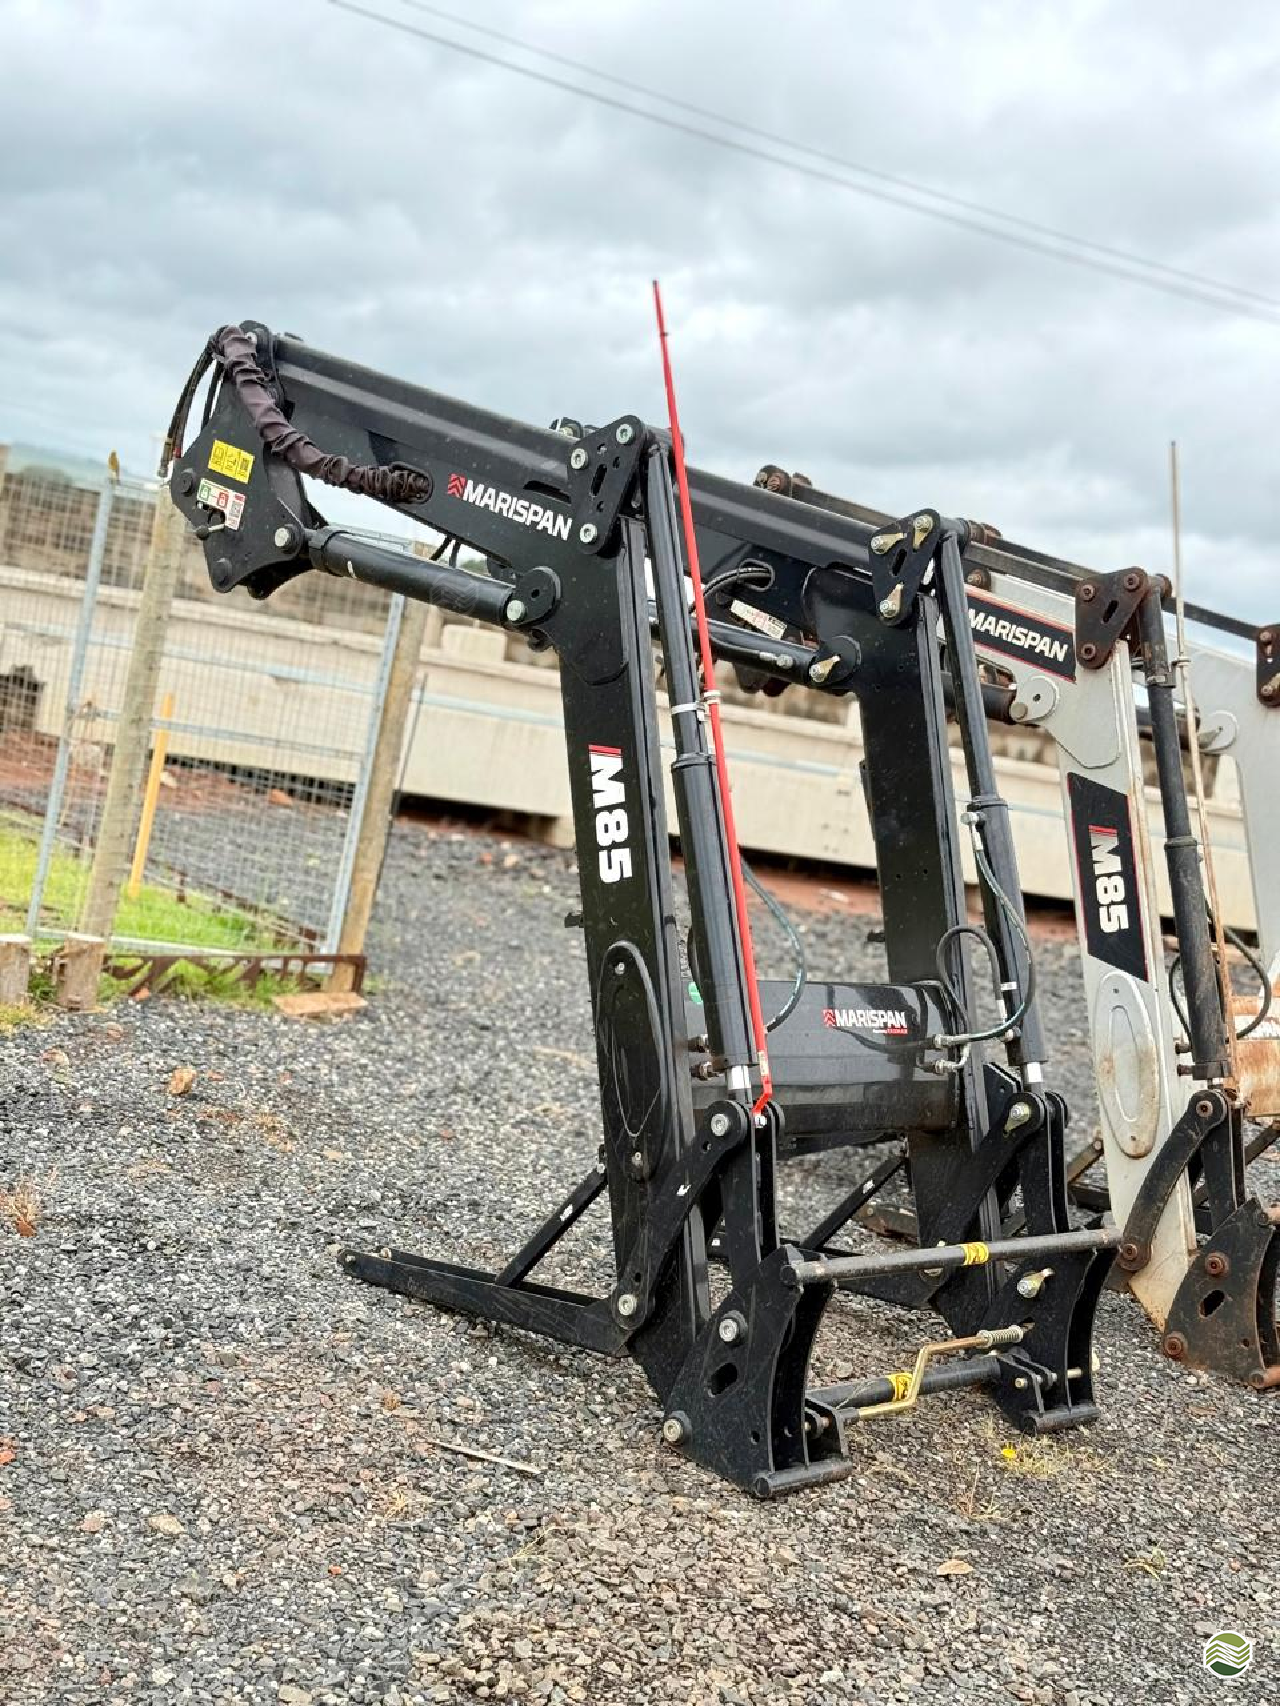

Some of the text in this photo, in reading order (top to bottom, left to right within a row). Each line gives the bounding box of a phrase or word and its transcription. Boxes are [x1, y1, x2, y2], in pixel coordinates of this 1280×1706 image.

[463, 480, 572, 541] MARISPAN
[968, 608, 1068, 662] MARISPAN
[589, 745, 632, 883] M85
[1088, 825, 1129, 933] M85
[834, 1009, 907, 1029] MARISPAN
